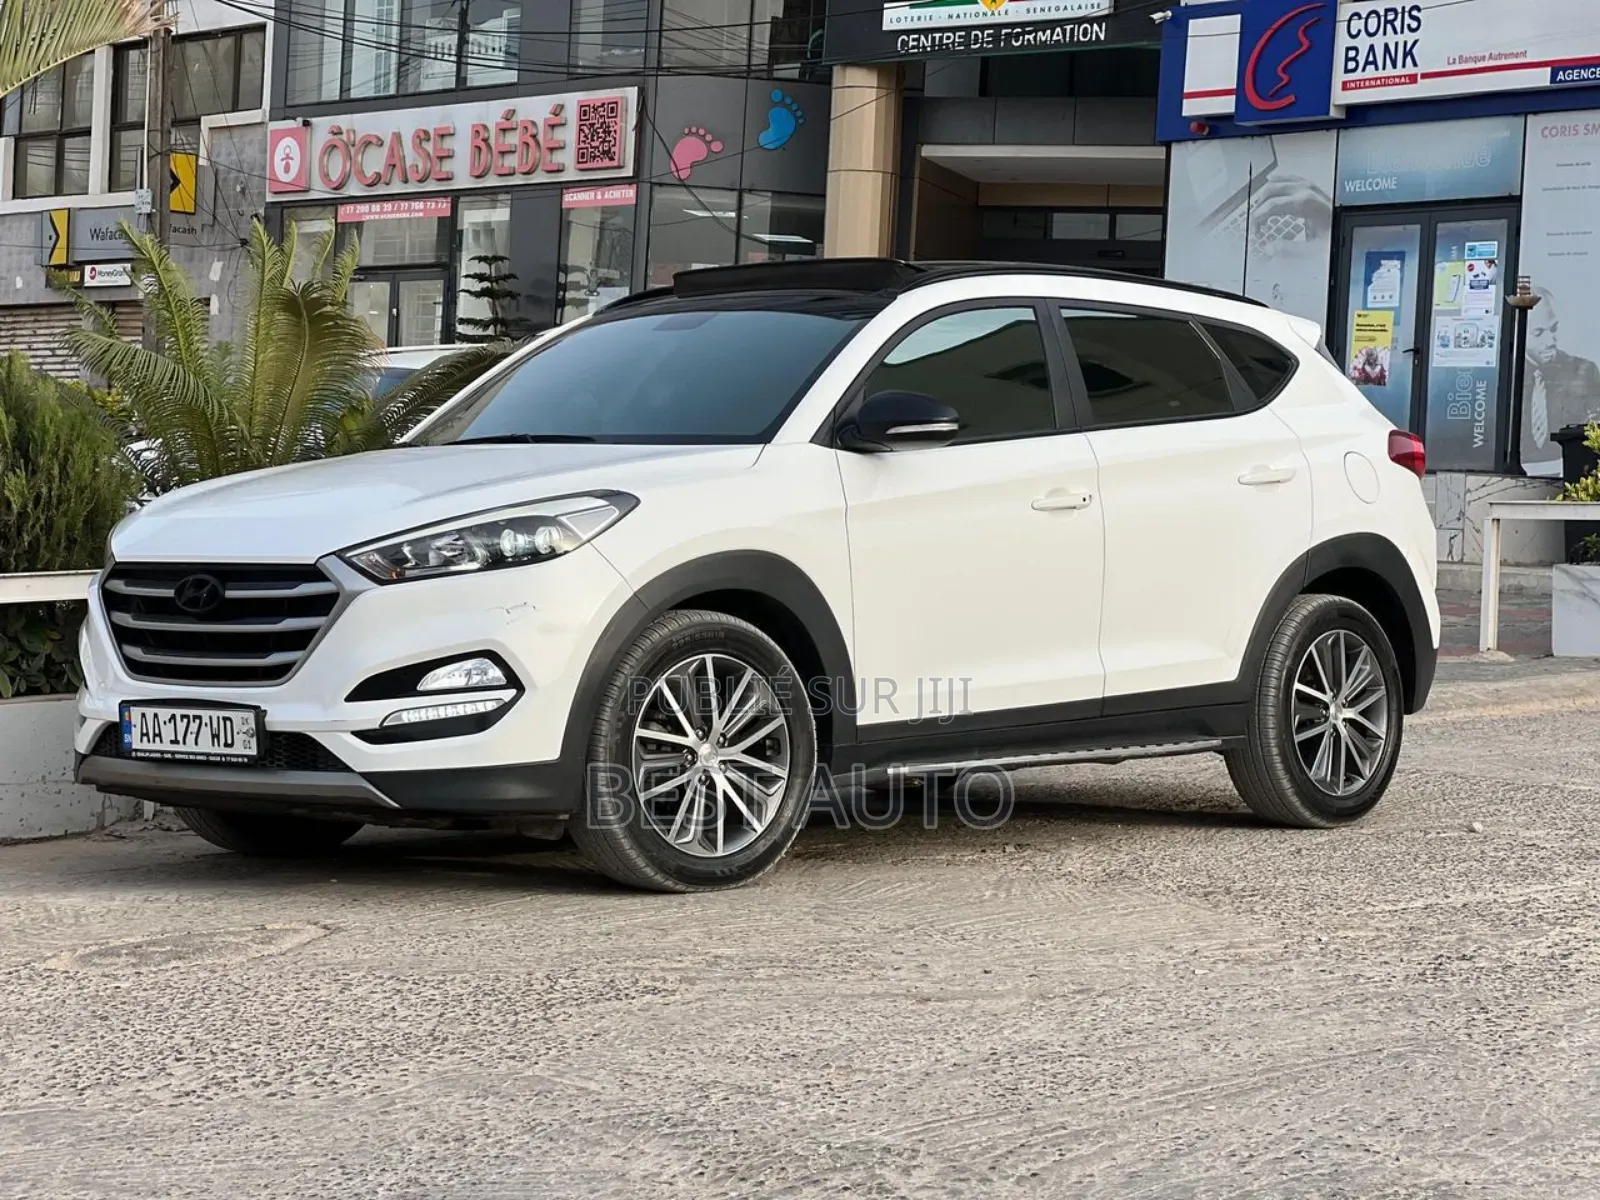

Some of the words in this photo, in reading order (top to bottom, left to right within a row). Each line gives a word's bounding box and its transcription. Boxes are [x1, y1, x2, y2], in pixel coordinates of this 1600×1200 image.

[889, 15, 933, 24] LOTERIE
[947, 9, 1009, 20] NATIONALE
[1026, 3, 1101, 14] SENEGALAISE
[1346, 4, 1422, 40] CORIS
[897, 31, 966, 53] CENTRE
[970, 29, 994, 49] DE
[1000, 22, 1106, 47] FORMATION
[1343, 39, 1420, 74] BANK
[1447, 56, 1457, 66] La
[1458, 54, 1486, 66] Banque
[1487, 50, 1527, 62] Autrement
[1346, 76, 1411, 89] INTERNATIONAL
[1556, 67, 1600, 82] AGENCE
[1541, 124, 1579, 138] CORIS
[469, 103, 567, 178] BÉBÉ
[1344, 176, 1398, 193] WELCOME
[603, 189, 634, 199] ACHETER
[89, 226, 129, 242] Wafaca
[170, 223, 197, 235] facash
[1472, 380, 1488, 448] WELCOME
